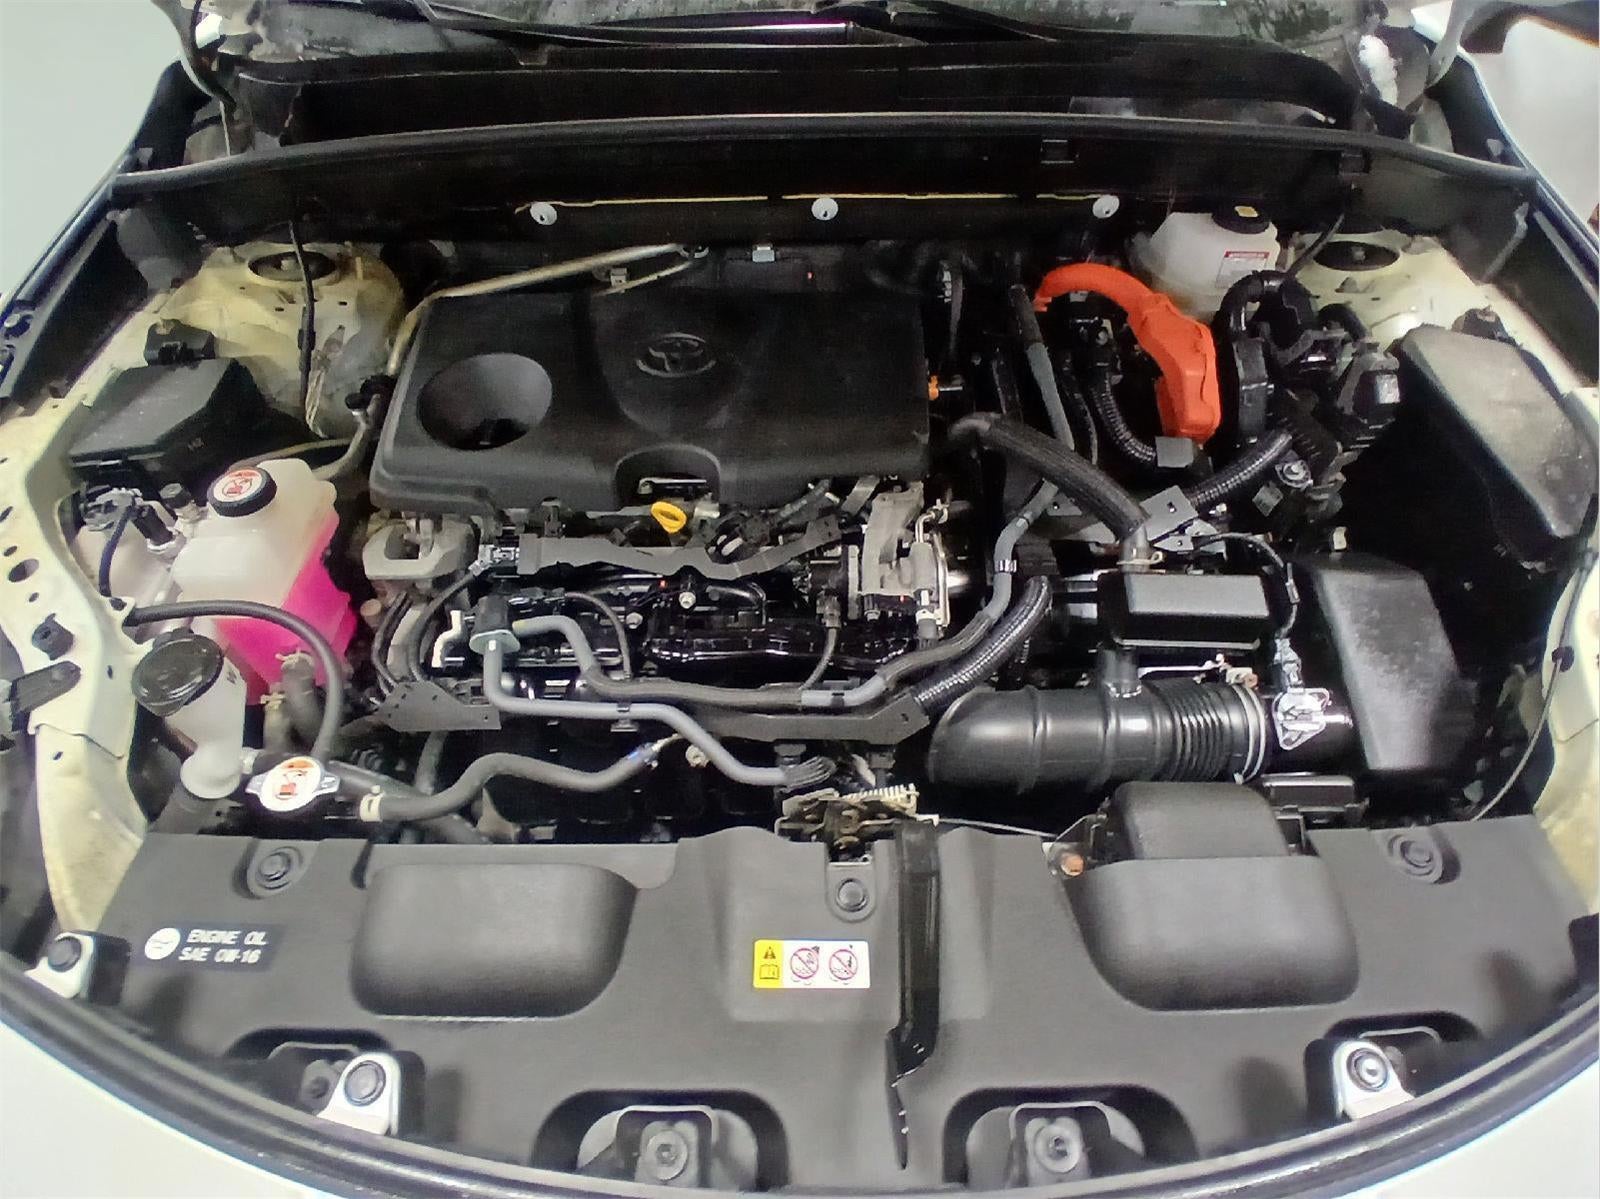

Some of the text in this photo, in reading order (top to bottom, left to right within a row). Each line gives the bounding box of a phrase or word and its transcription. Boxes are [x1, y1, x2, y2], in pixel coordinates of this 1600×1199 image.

[186, 929, 268, 945] ENGINE OIL
[178, 947, 211, 961] SAE
